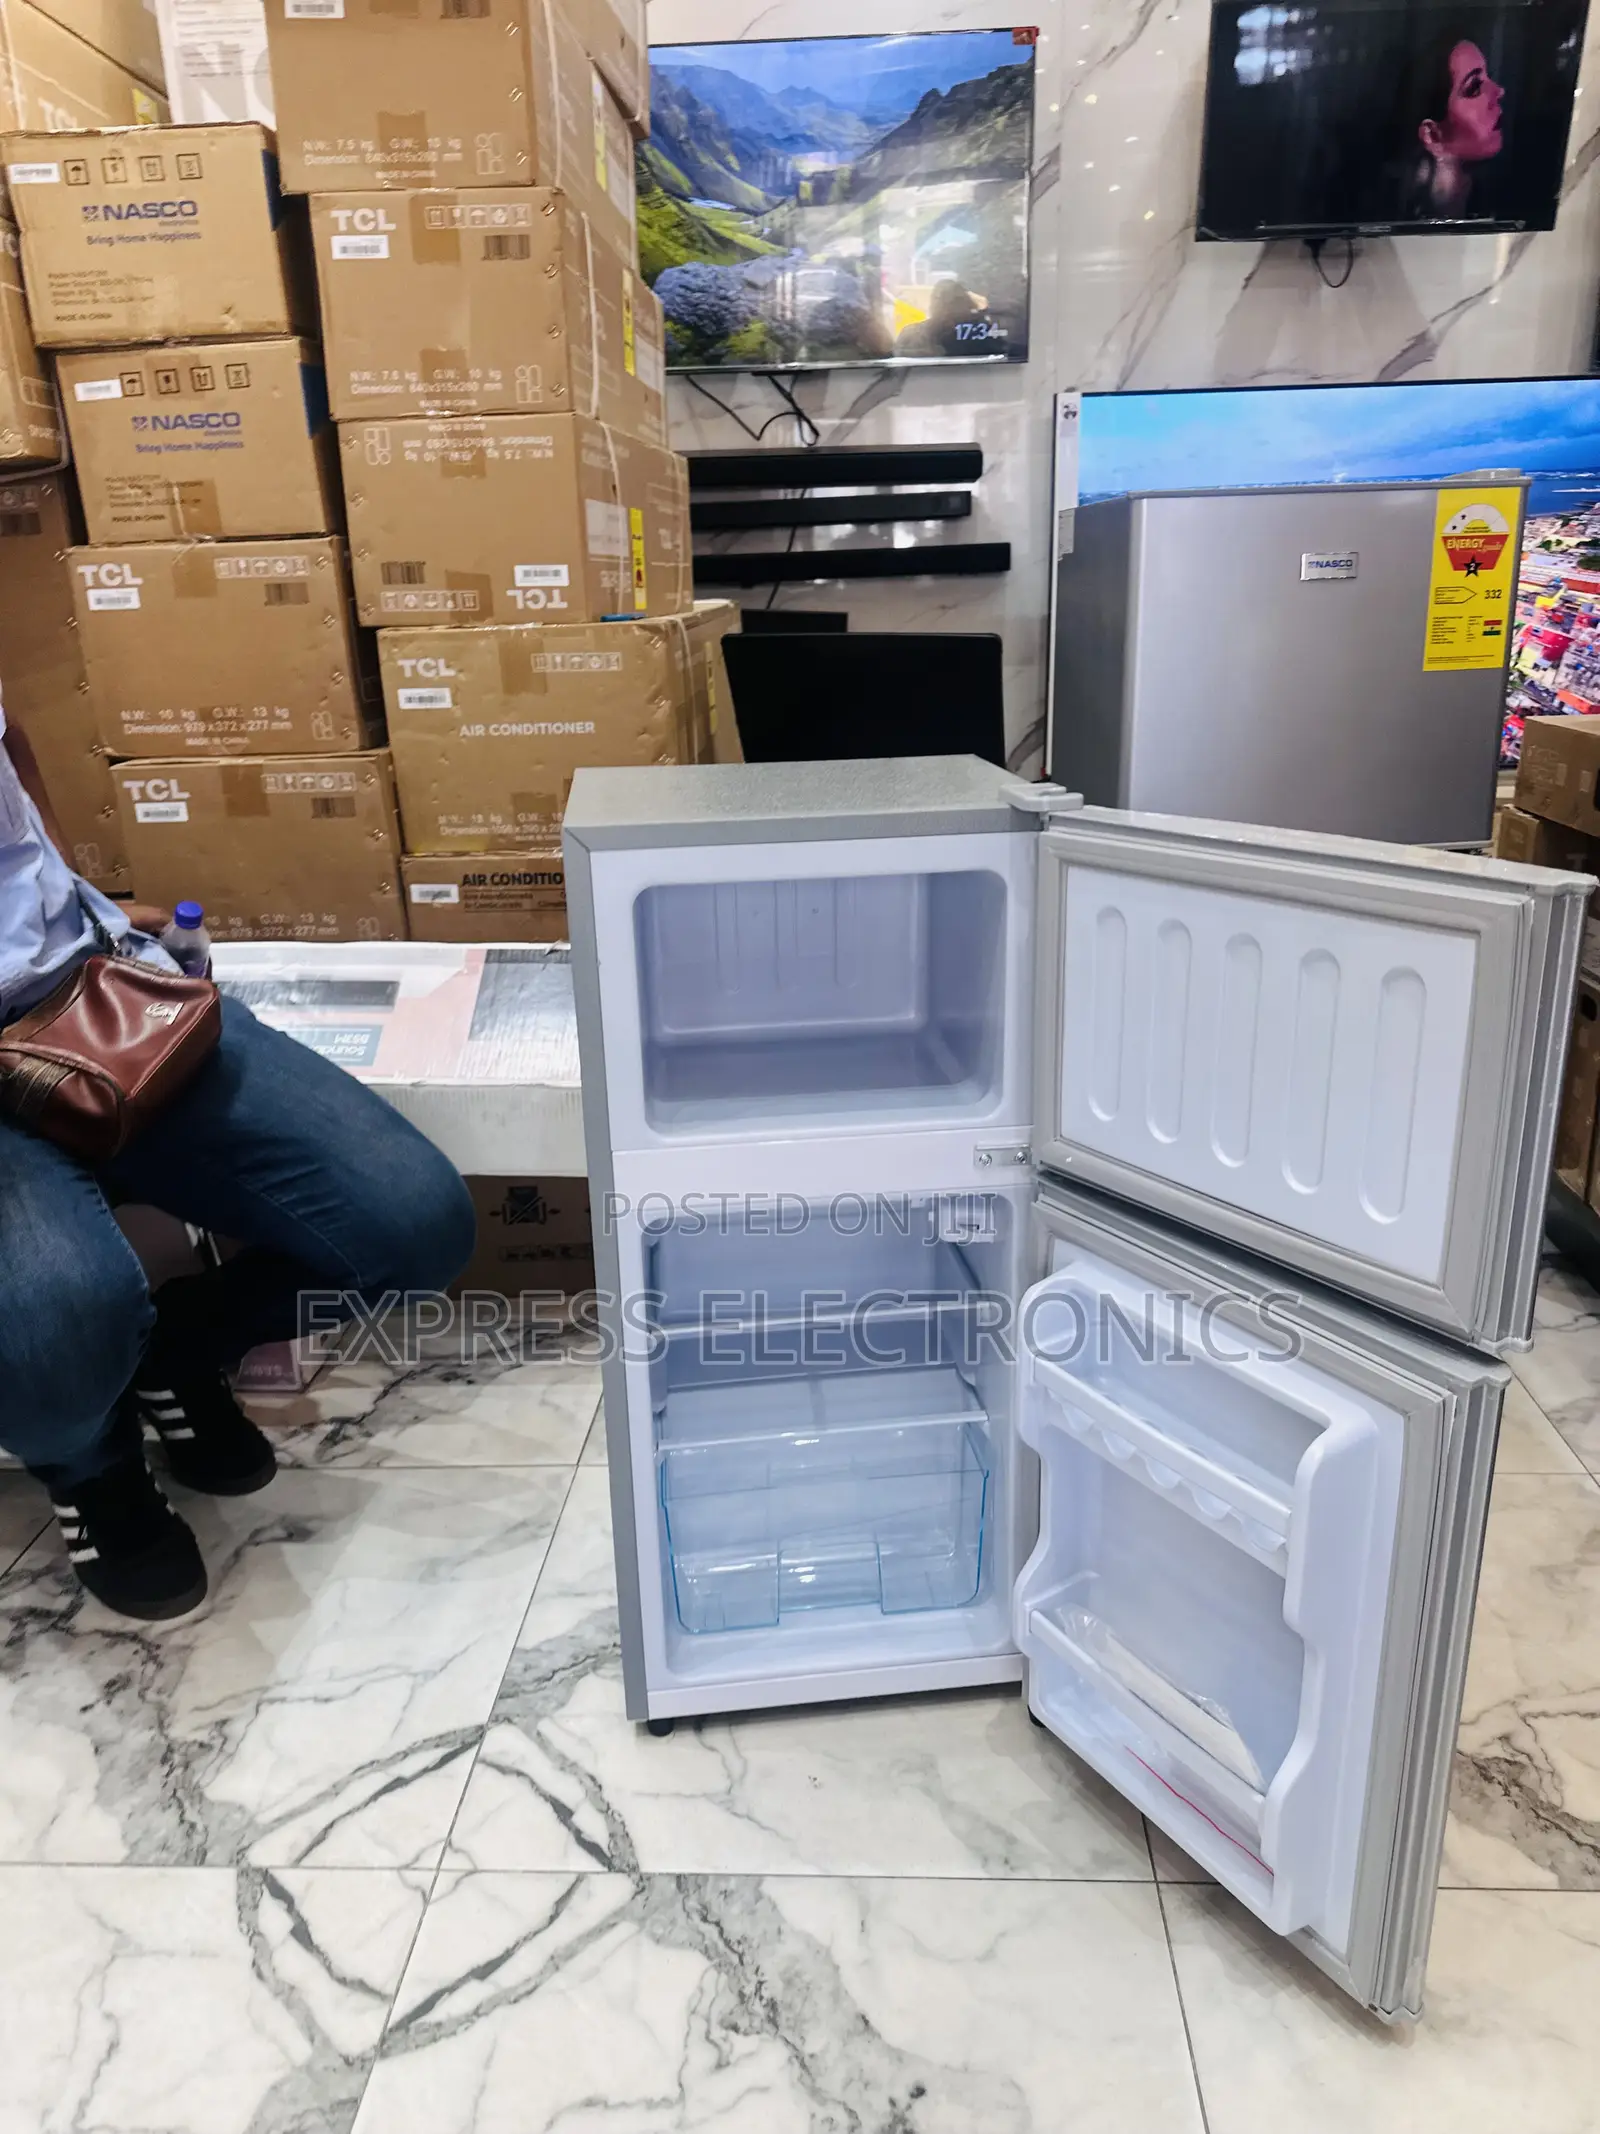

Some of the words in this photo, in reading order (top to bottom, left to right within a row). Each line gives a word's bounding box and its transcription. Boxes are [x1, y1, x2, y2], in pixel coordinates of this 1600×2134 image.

[103, 200, 198, 221] NASCO
[330, 207, 397, 232] TCL
[86, 235, 114, 247] Bring
[955, 322, 1000, 340] 17:34
[151, 412, 241, 431] NASCO
[1447, 538, 1486, 550] ENERGY
[1315, 559, 1353, 569] NASCO
[1469, 563, 1476, 571] 2
[77, 563, 143, 587] TCL
[506, 589, 568, 610] TCL
[1484, 589, 1503, 599] 332
[398, 658, 456, 677] TCL
[180, 708, 196, 721] kg
[252, 706, 268, 717] 13
[274, 705, 290, 719] kg
[459, 724, 485, 737] AIR
[489, 721, 595, 736] CONDITIONER
[123, 779, 191, 802] TCL
[462, 874, 488, 887] AIR
[490, 872, 564, 886] CONDITIO
